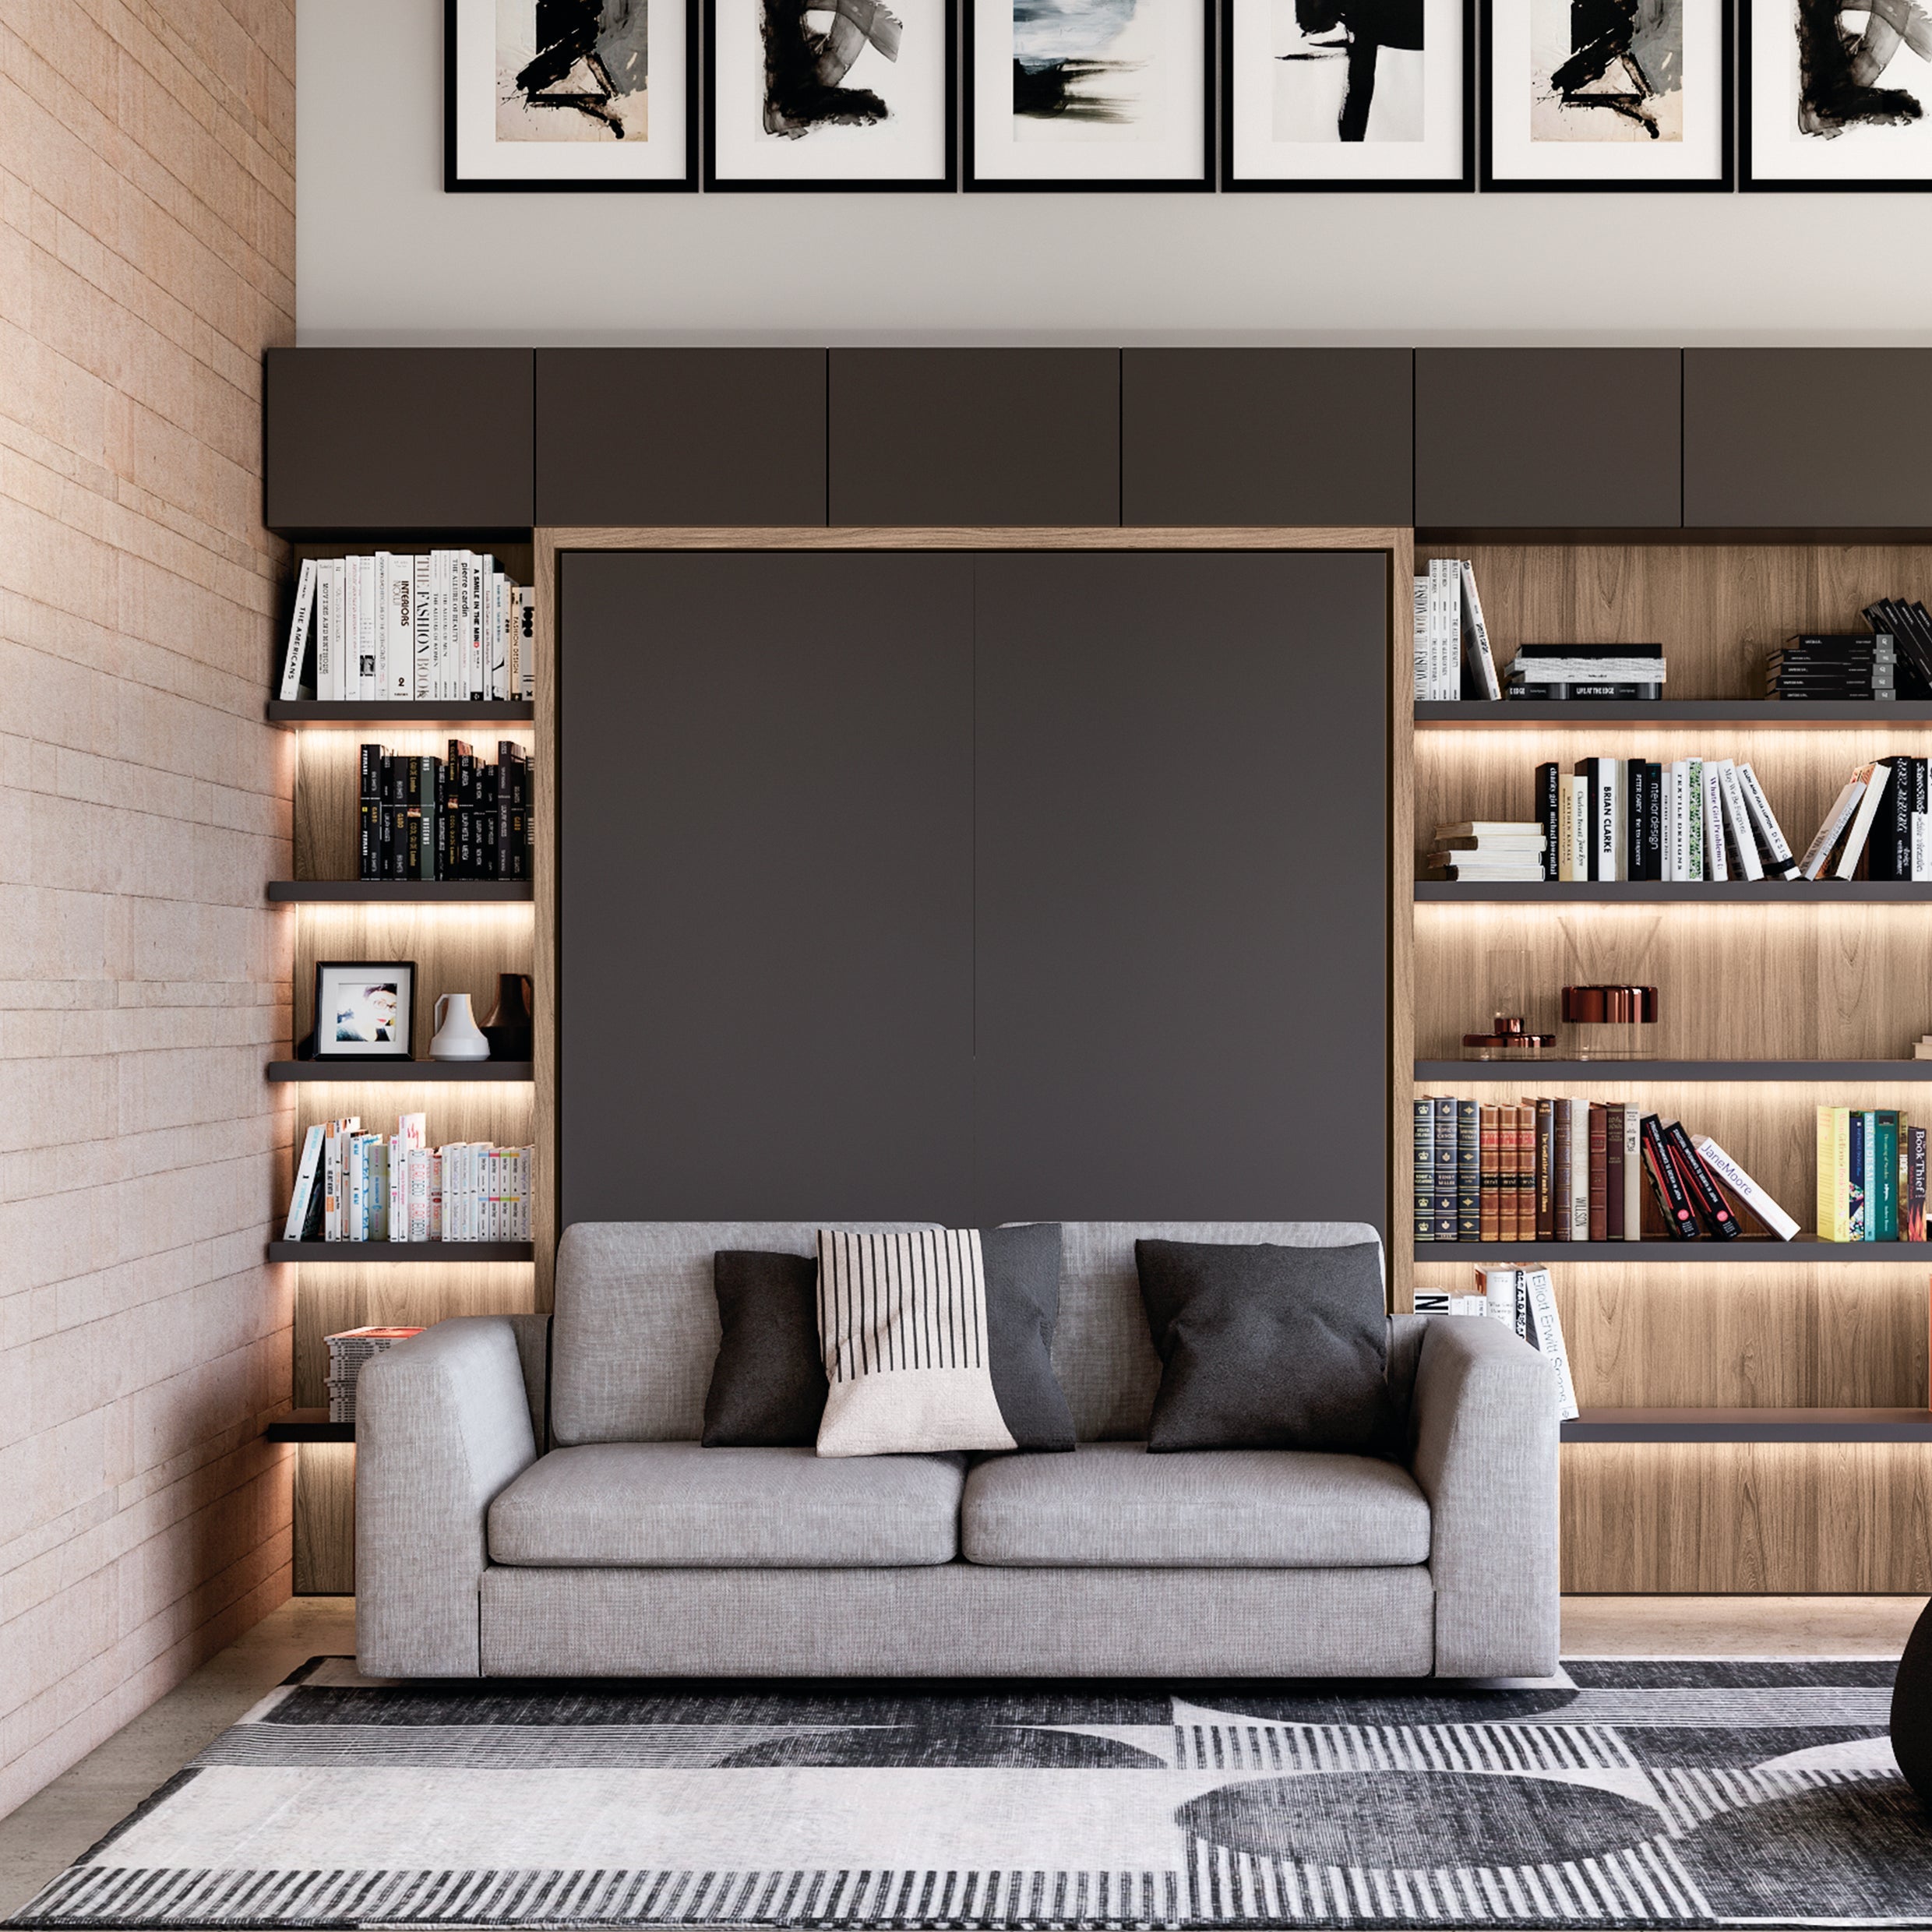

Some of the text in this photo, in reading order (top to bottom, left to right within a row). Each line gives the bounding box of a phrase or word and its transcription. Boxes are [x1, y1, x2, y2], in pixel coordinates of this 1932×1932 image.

[460, 562, 469, 588] pierre
[453, 604, 457, 612] OF
[287, 606, 305, 680] THE AMERICANS
[417, 558, 428, 698] THE FASHION BOOK
[399, 678, 404, 686] 2
[1549, 767, 1557, 807] charity girl
[1723, 768, 1733, 783] May
[1729, 783, 1736, 796] We
[1743, 769, 1753, 783] ELLEN
[1749, 784, 1759, 795] AND
[1732, 796, 1739, 806] Be
[1603, 819, 1612, 853] CLARKE
[1649, 816, 1659, 850] design
[1713, 825, 1723, 862] Problems
[1772, 832, 1788, 861] DESIG
[1701, 1144, 1752, 1196] JaneMoore
[1916, 1130, 1925, 1193] Book Thief
[1574, 1197, 1587, 1227] WILLSON
[1532, 1274, 1550, 1310] Elliott
[1540, 1315, 1558, 1352] Erwitt
